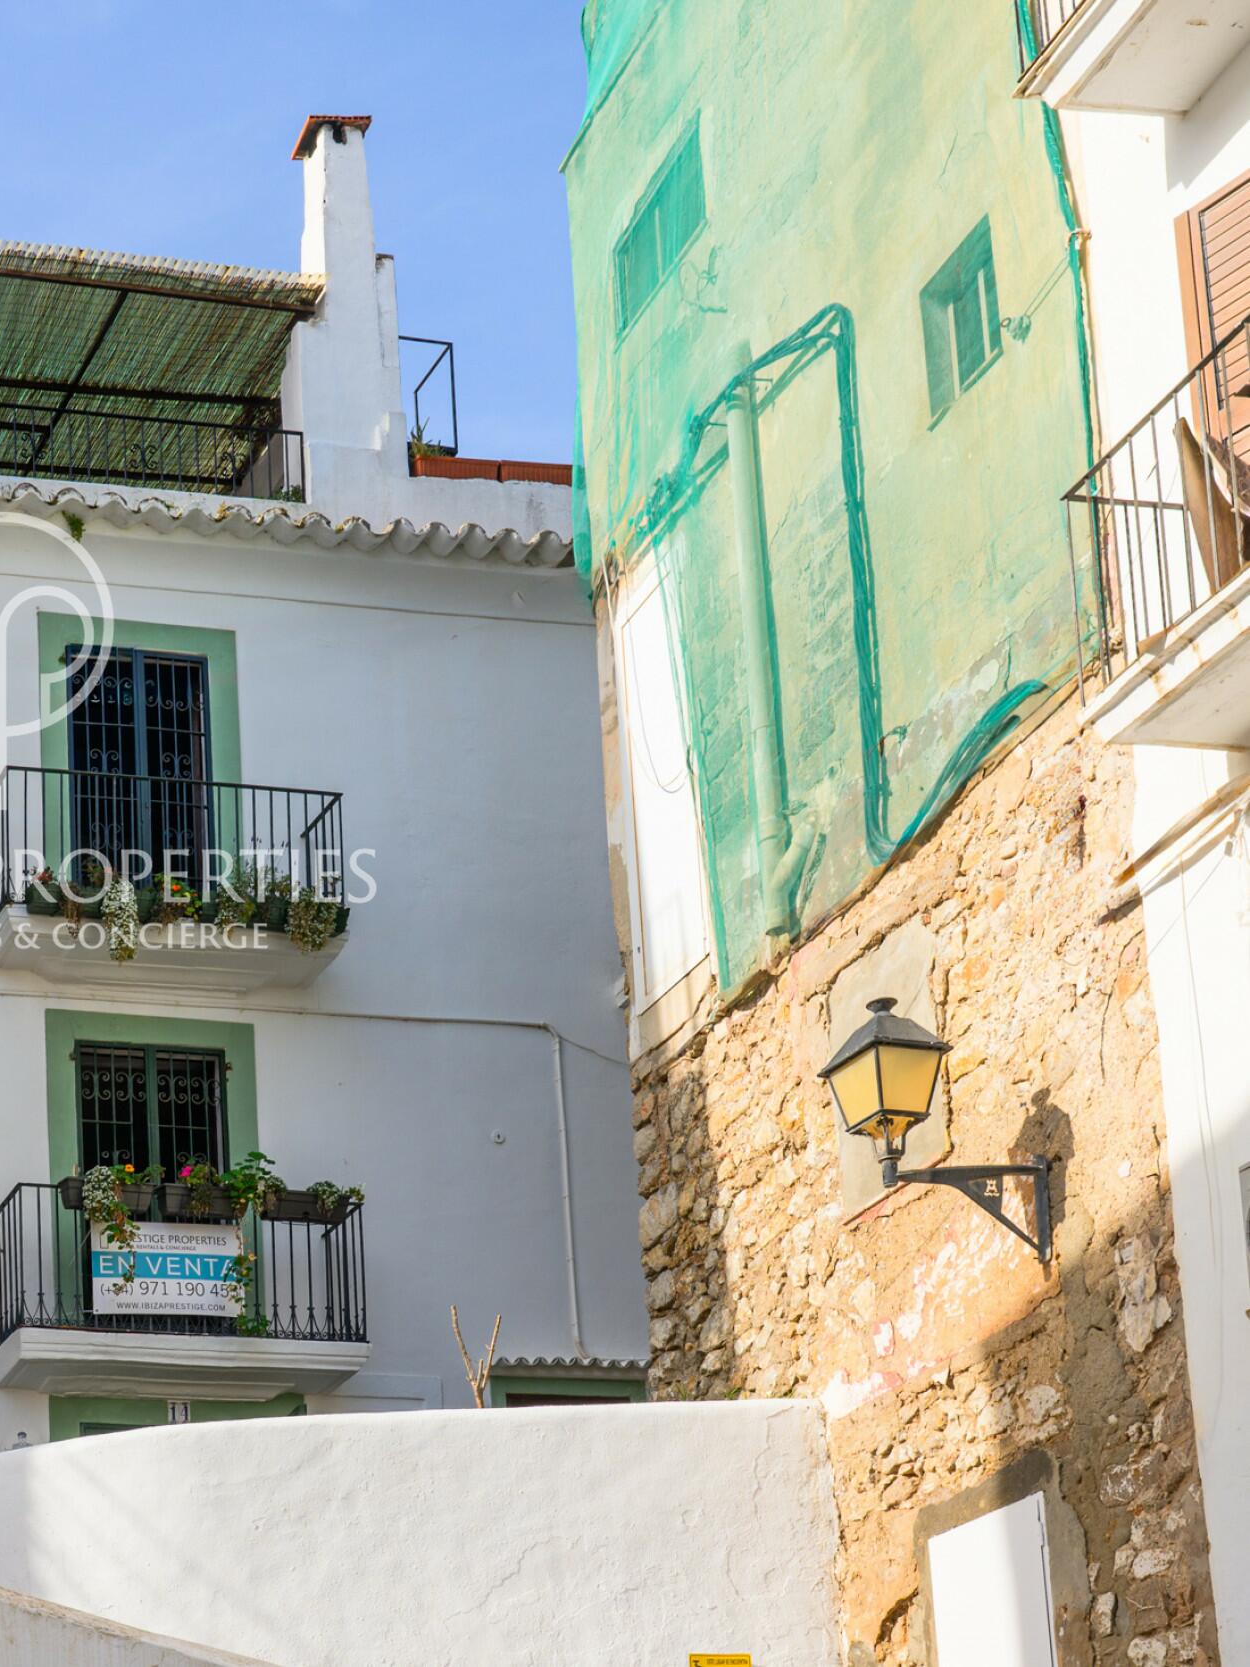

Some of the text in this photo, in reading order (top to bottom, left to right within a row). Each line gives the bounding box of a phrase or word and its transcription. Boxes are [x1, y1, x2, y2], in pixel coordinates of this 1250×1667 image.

[168, 1234, 227, 1247] PROPERTIES
[99, 1255, 238, 1277] EN VENTA
[139, 1280, 169, 1296] 971
[176, 1282, 206, 1297] 190
[116, 1301, 226, 1312] WWW.IBIZAPRESTIGE.COM
[170, 1402, 189, 1424] 14
